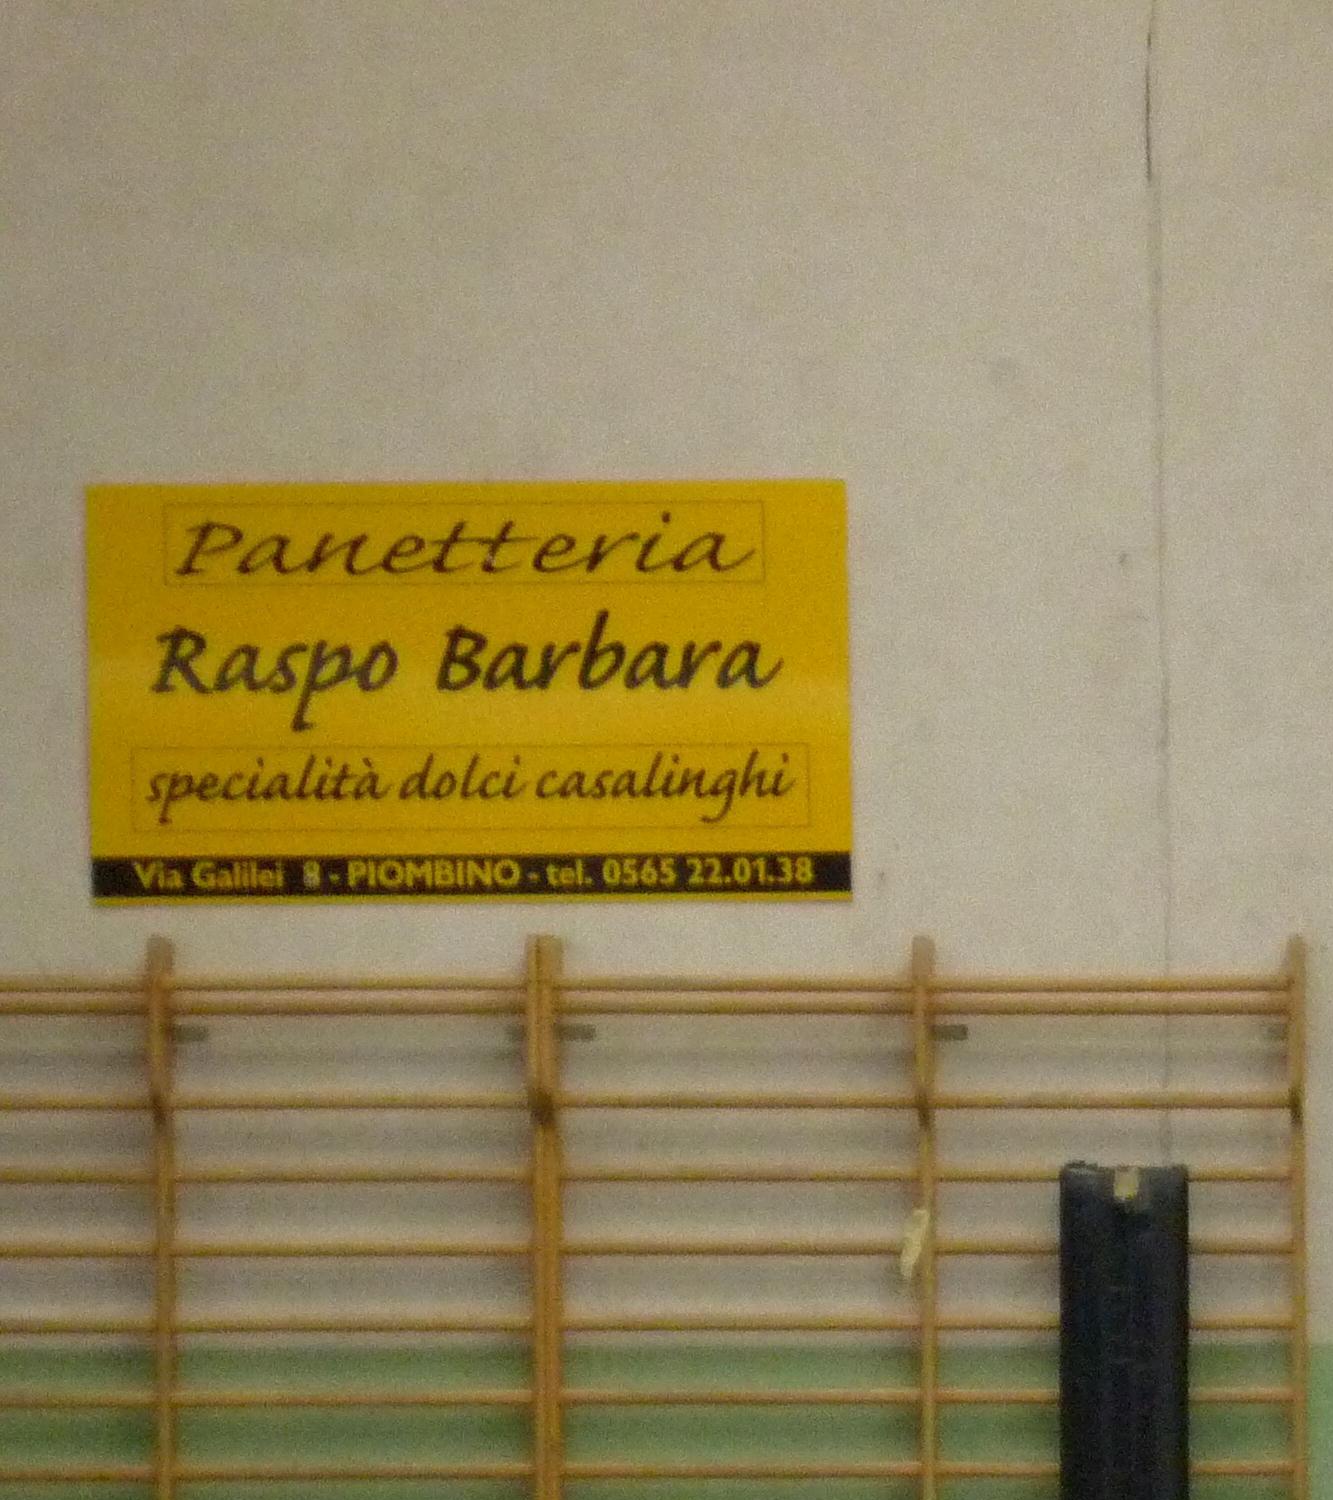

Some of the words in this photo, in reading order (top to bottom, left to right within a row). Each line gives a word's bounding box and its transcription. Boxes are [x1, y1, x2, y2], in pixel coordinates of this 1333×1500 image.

[174, 511, 756, 578] Panetteria
[150, 624, 400, 731] Raspo
[436, 611, 784, 693] Barbara
[145, 752, 392, 824] specialità
[399, 753, 525, 803] dolci
[534, 750, 796, 823] casalinghi
[134, 861, 186, 889] Via
[189, 861, 284, 889] Galilei
[301, 861, 321, 888] 8
[347, 859, 521, 887] PIOMBINO
[546, 858, 593, 885] tel.
[602, 857, 677, 884] 0565
[685, 856, 814, 884] 22.01.38
